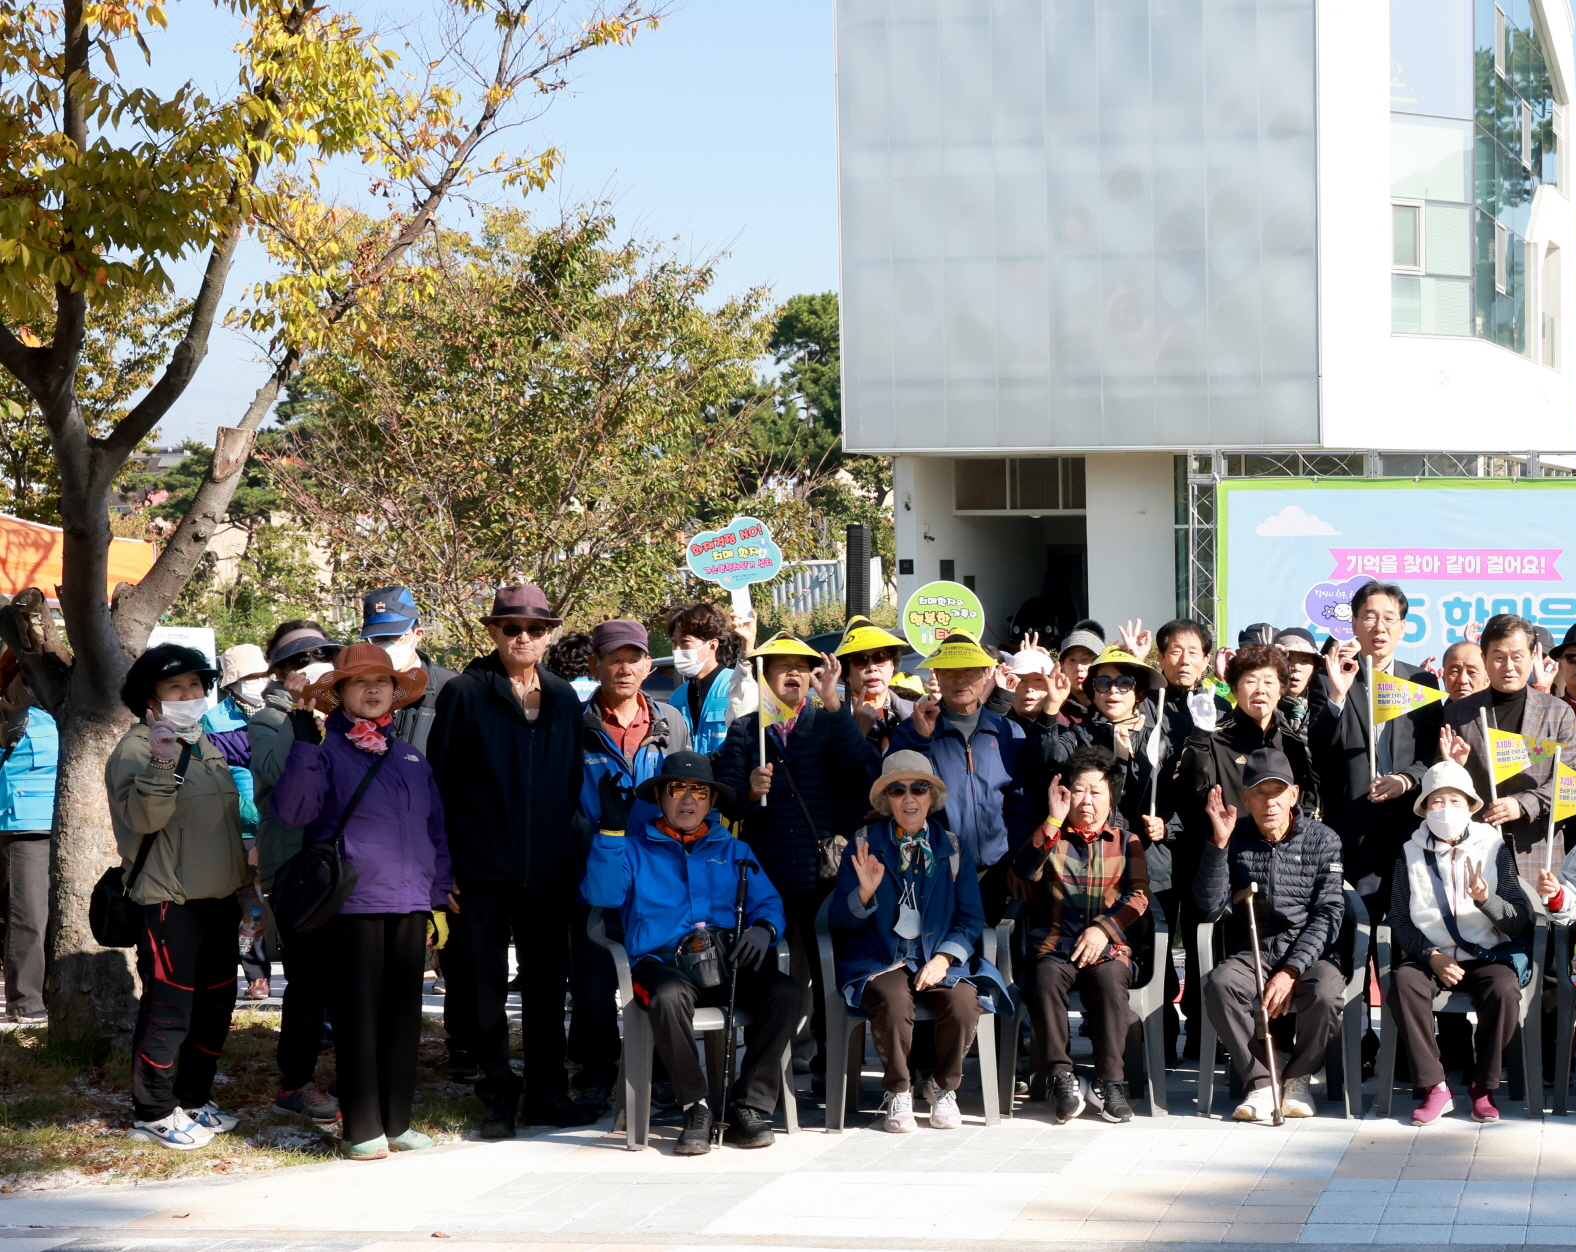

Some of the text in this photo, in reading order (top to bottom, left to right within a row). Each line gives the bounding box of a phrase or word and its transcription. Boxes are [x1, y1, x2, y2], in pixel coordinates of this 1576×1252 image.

[739, 524, 763, 540] NO!
[711, 549, 734, 561] 치매
[1346, 555, 1546, 574] 기억을 찾아 같이 걸어요!
[909, 611, 951, 627] 행복한
